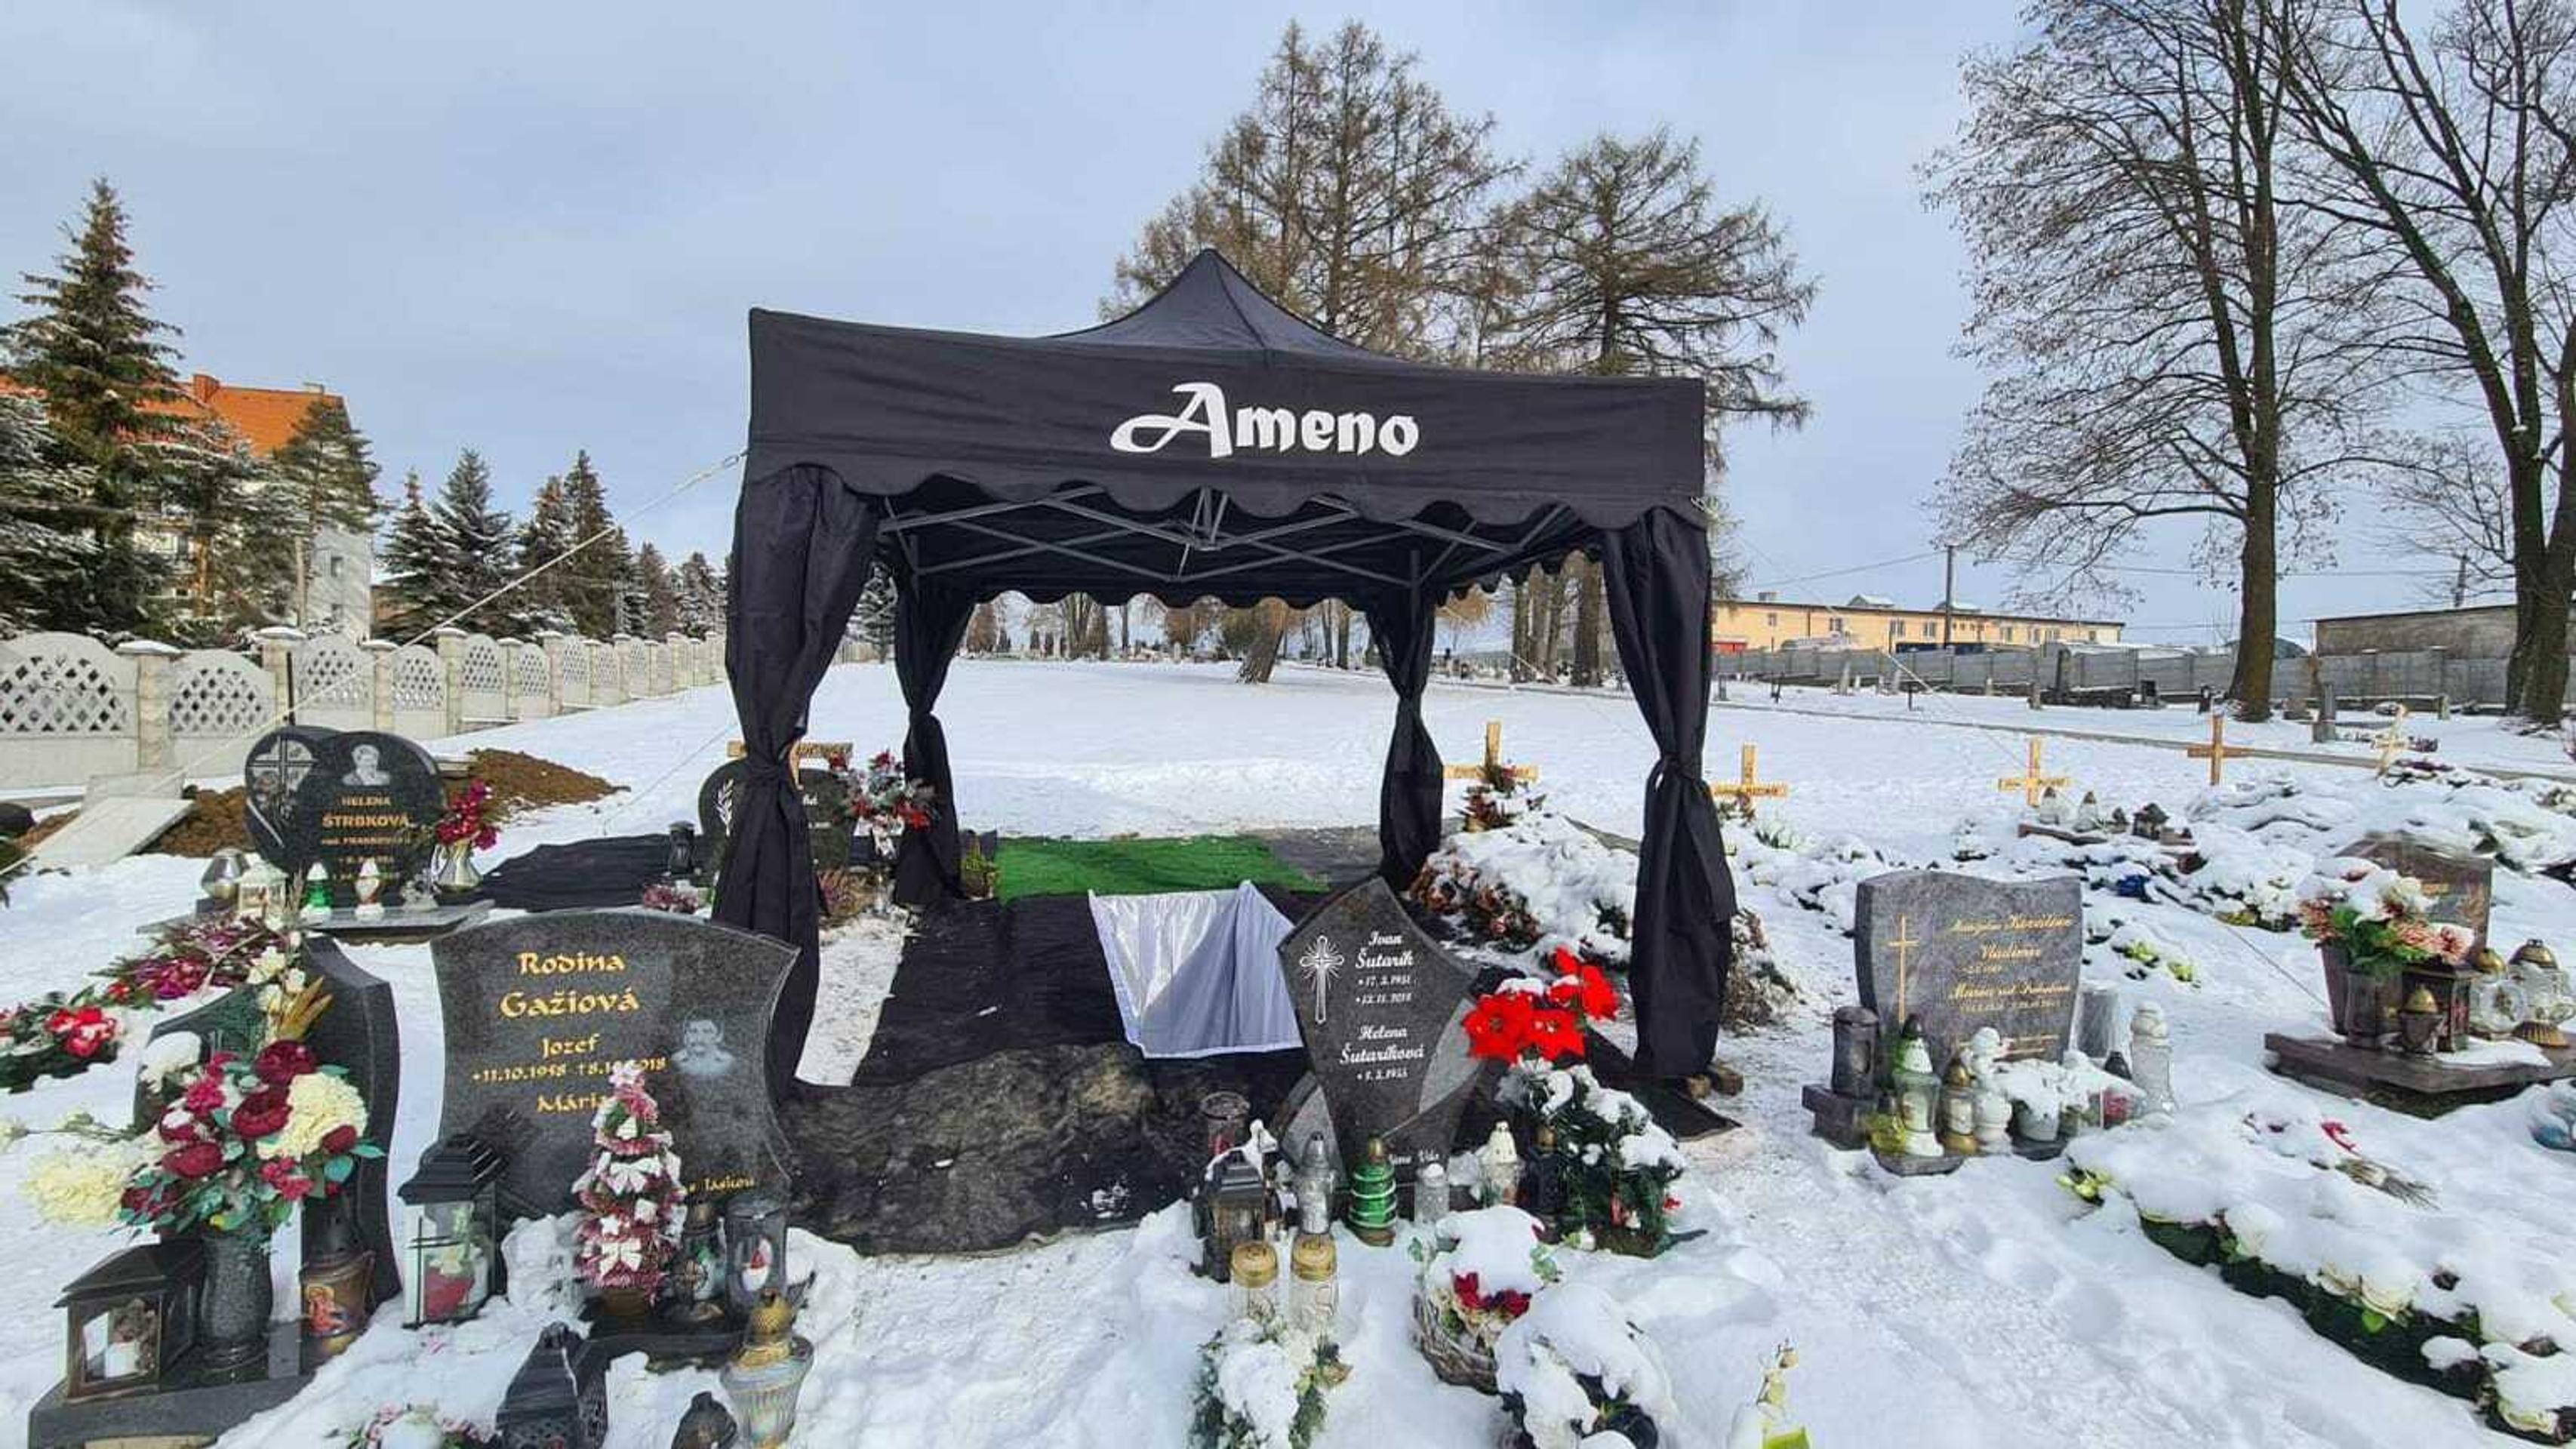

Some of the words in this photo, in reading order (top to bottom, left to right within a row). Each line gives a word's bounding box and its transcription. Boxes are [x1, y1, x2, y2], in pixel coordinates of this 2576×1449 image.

[1110, 382, 1420, 459] Ameno
[341, 796, 391, 807] HELENA
[517, 951, 626, 975] Rodina
[500, 986, 640, 1018] Gažiová
[1358, 1024, 1408, 1040] Helena
[541, 1033, 601, 1058] Jozef
